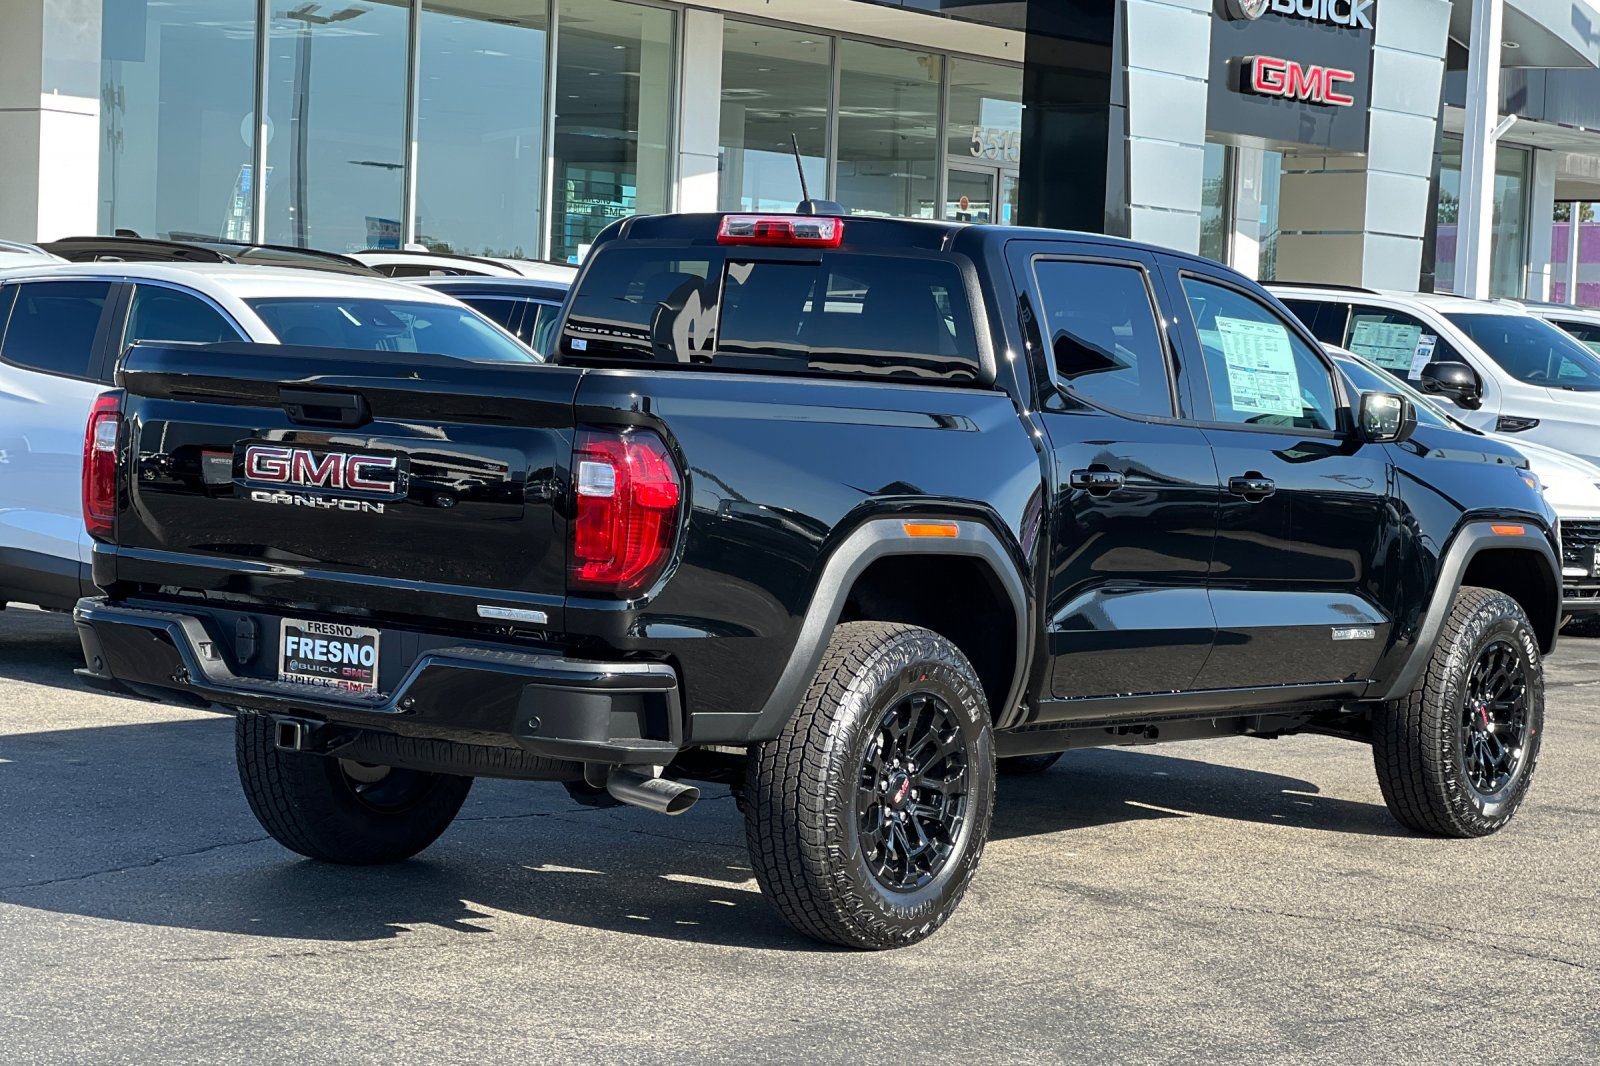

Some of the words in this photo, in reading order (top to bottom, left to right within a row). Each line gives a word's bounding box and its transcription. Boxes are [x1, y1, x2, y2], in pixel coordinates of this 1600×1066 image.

[1252, 55, 1355, 106] GMC
[970, 126, 1020, 163] 5515
[245, 446, 397, 494] GMC
[251, 491, 385, 514] CANYON
[307, 622, 353, 636] FRESNO
[286, 636, 375, 667] FRESNO
[298, 663, 338, 673] BUICK
[342, 667, 371, 678] GMC
